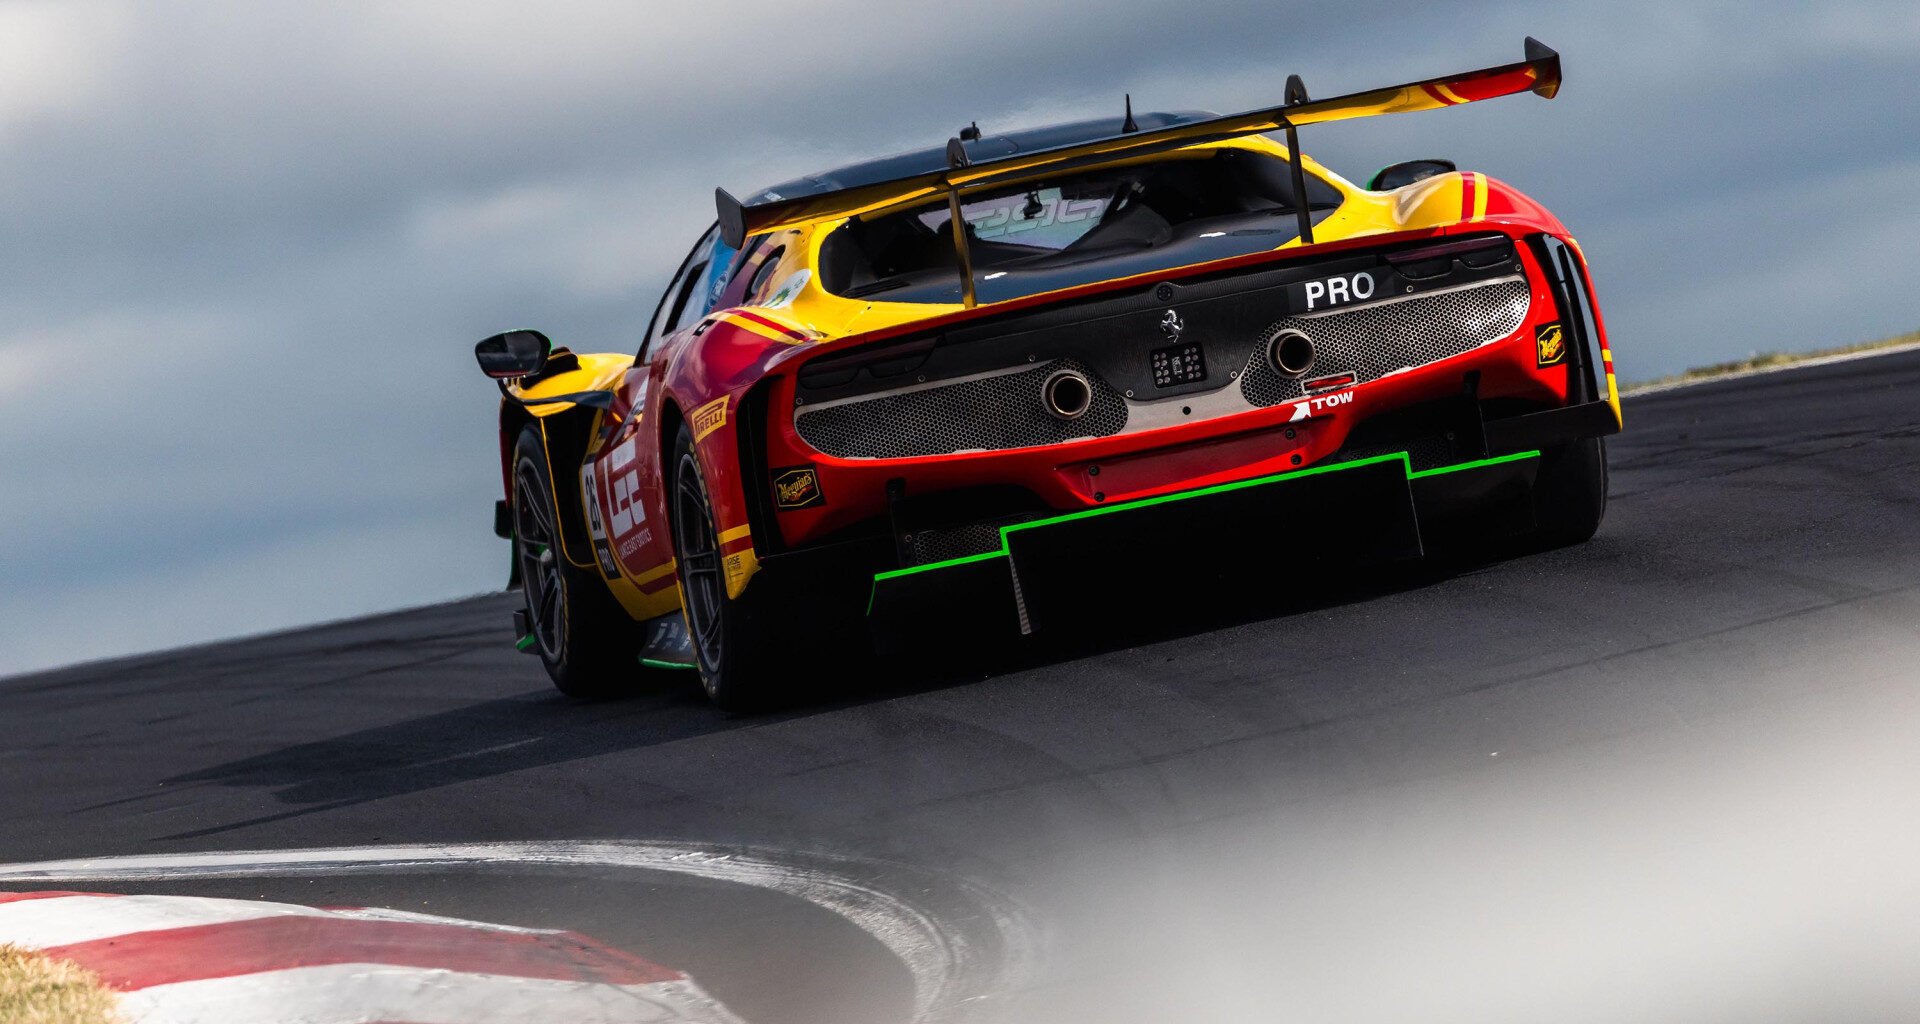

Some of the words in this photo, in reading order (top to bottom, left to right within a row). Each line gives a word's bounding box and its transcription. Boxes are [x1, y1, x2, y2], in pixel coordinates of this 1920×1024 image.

[1305, 272, 1375, 309] PRO
[1311, 391, 1354, 410] TOW
[694, 401, 725, 438] PIRELLI
[585, 474, 602, 531] 26
